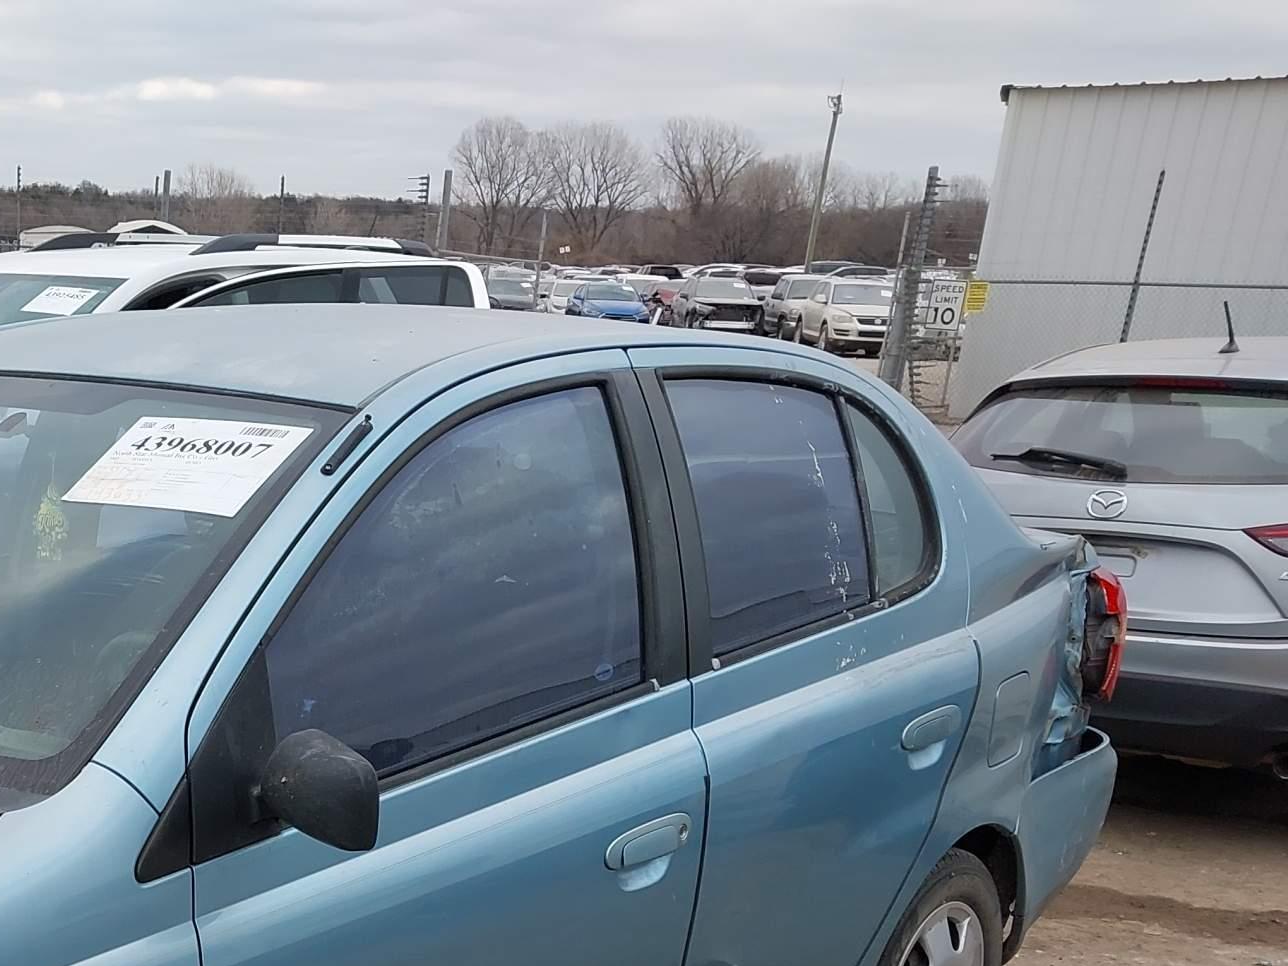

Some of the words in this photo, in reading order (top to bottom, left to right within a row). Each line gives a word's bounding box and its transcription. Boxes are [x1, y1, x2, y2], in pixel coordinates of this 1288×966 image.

[934, 284, 965, 294] SPEED
[935, 296, 959, 305] LIMIT
[933, 307, 955, 325] 10
[130, 435, 275, 459] 43968007
